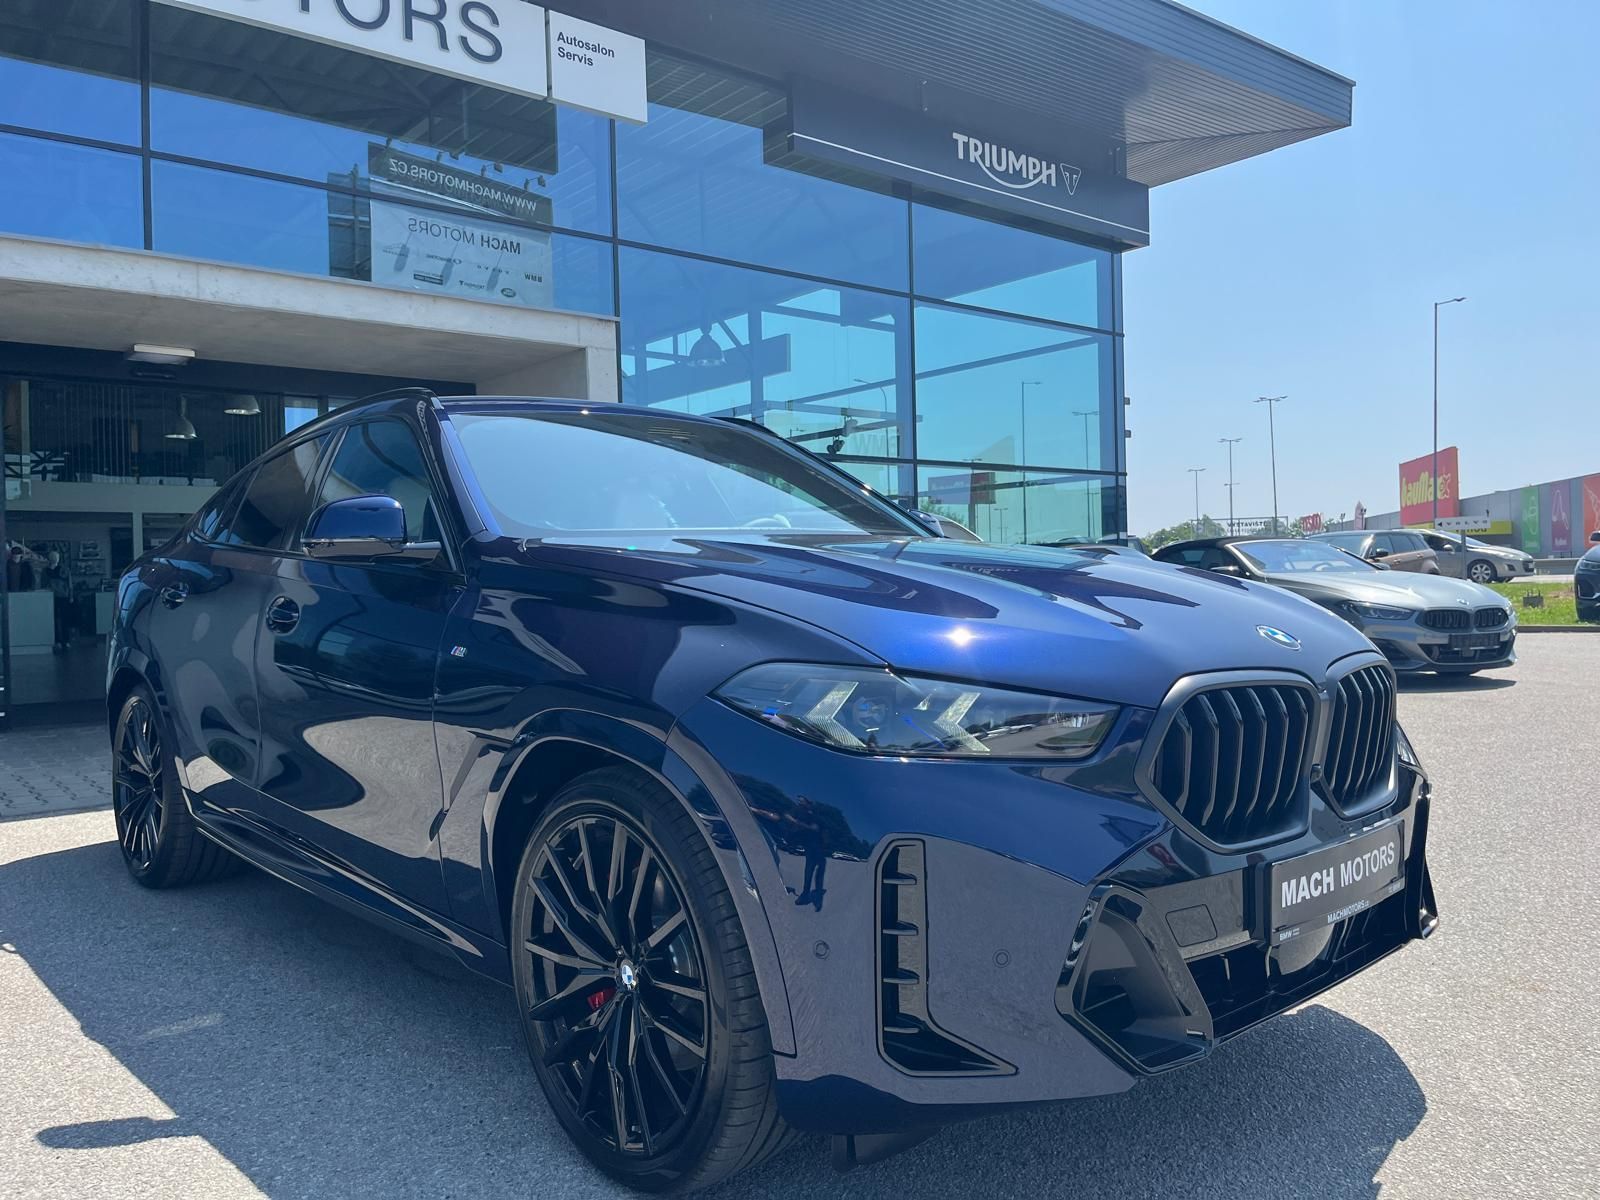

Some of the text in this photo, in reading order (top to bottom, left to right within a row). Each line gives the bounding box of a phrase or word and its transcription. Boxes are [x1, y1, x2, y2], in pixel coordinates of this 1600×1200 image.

[298, 0, 503, 63] ORS
[557, 31, 615, 58] Autosalon
[557, 46, 594, 66] Servis
[952, 132, 1057, 189] TRIUMPH
[1281, 841, 1395, 909] MACH MOTORS
